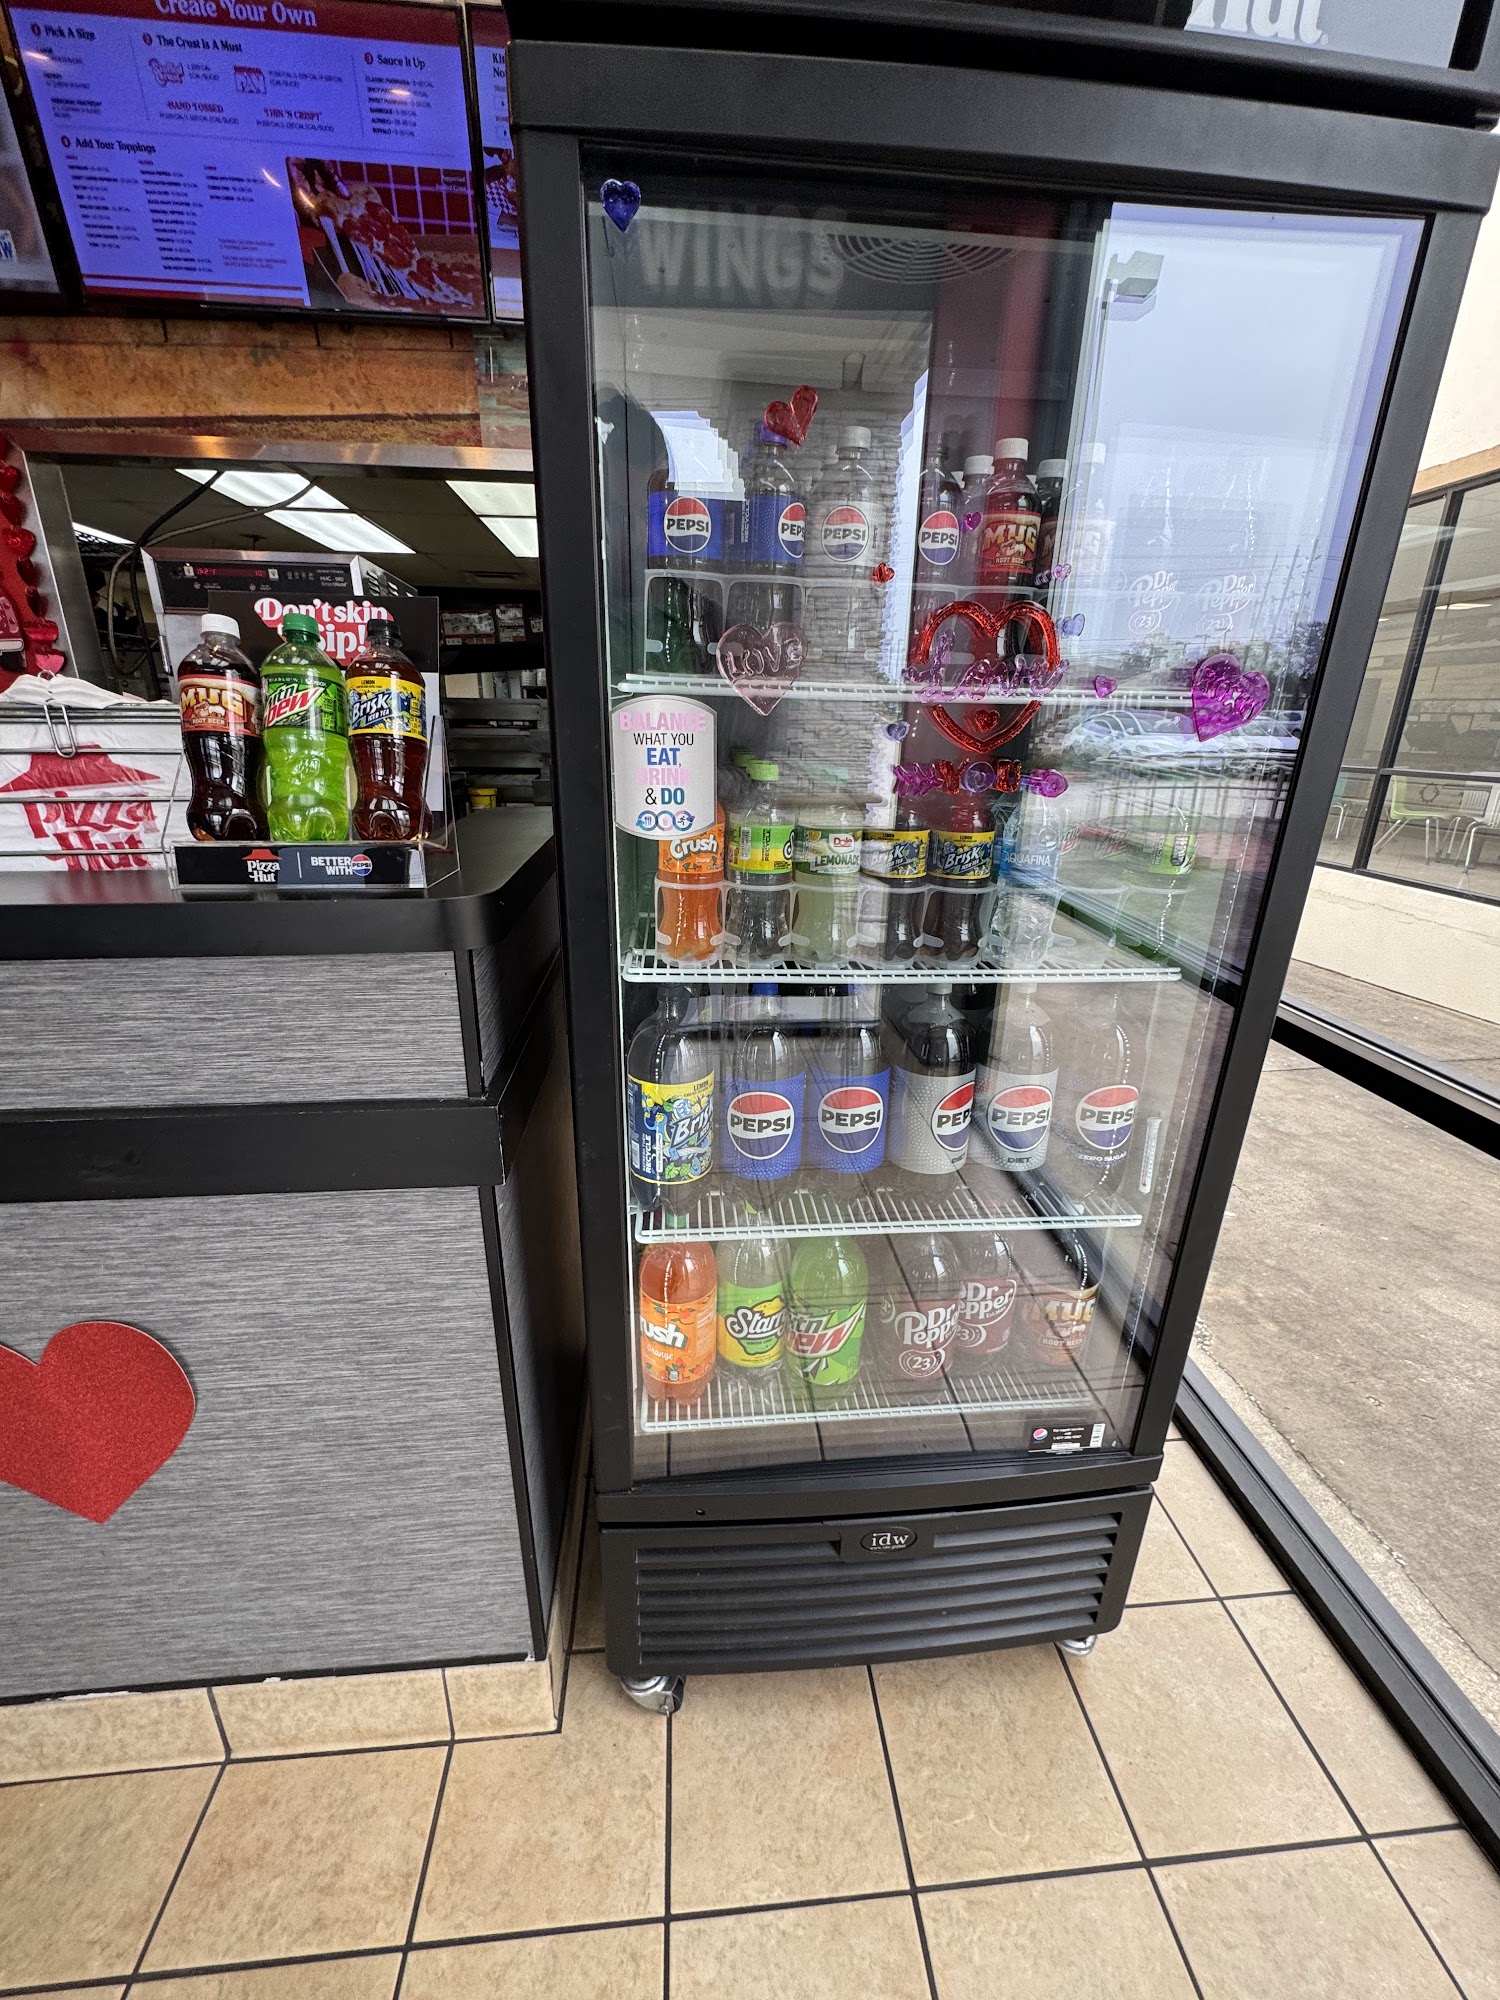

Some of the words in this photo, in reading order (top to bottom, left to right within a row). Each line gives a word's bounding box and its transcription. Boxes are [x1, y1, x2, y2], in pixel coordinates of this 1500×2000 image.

[220, 0, 267, 22] Your
[271, 1, 317, 27] Own
[44, 24, 65, 37] Pick
[67, 27, 77, 38] A
[77, 28, 96, 42] Size
[157, 34, 175, 47] The
[175, 36, 200, 49] Crust
[200, 38, 211, 49] Is
[212, 39, 220, 50] A
[220, 40, 243, 53] Must
[377, 54, 403, 67] Sauce
[404, 55, 412, 67] It
[412, 56, 426, 71] Up
[166, 100, 192, 111] HAND
[75, 137, 94, 149] Add
[94, 138, 115, 151] Your
[116, 140, 157, 155] Toppings
[666, 518, 709, 533] PEPSI
[823, 527, 867, 541] PEPSI
[921, 531, 957, 546] PEPSI
[982, 524, 1038, 554] MUG
[1137, 615, 1153, 628] 23
[181, 686, 245, 717] MUG
[619, 711, 706, 732] BALANCE
[633, 732, 668, 746] WHAT
[671, 732, 695, 746] YOU
[646, 747, 682, 768] EAT,
[634, 767, 693, 786] DRINK
[645, 787, 657, 805] &
[660, 787, 686, 805] DO
[23, 789, 159, 838] Pizza
[46, 830, 152, 871] Hut
[670, 833, 718, 859] Crush
[247, 860, 280, 873] Pizza
[310, 856, 352, 867] BETTER
[944, 847, 980, 870] Brisk
[1004, 852, 1052, 867] AQUAFINA
[249, 871, 276, 883] Hut
[325, 866, 354, 876] WITH
[730, 1114, 791, 1133] PEPSI
[821, 1108, 881, 1127] PEPSI
[991, 1108, 1050, 1126] PEPSI
[1077, 1153, 1104, 1162] ZERO
[967, 1281, 999, 1302] Dr
[958, 1287, 1014, 1321] epper
[927, 1303, 956, 1330] Dr
[1042, 1337, 1064, 1346] ROOT
[646, 1343, 674, 1360] Orange
[912, 1356, 931, 1370] 23
[871, 1532, 909, 1547] idw
